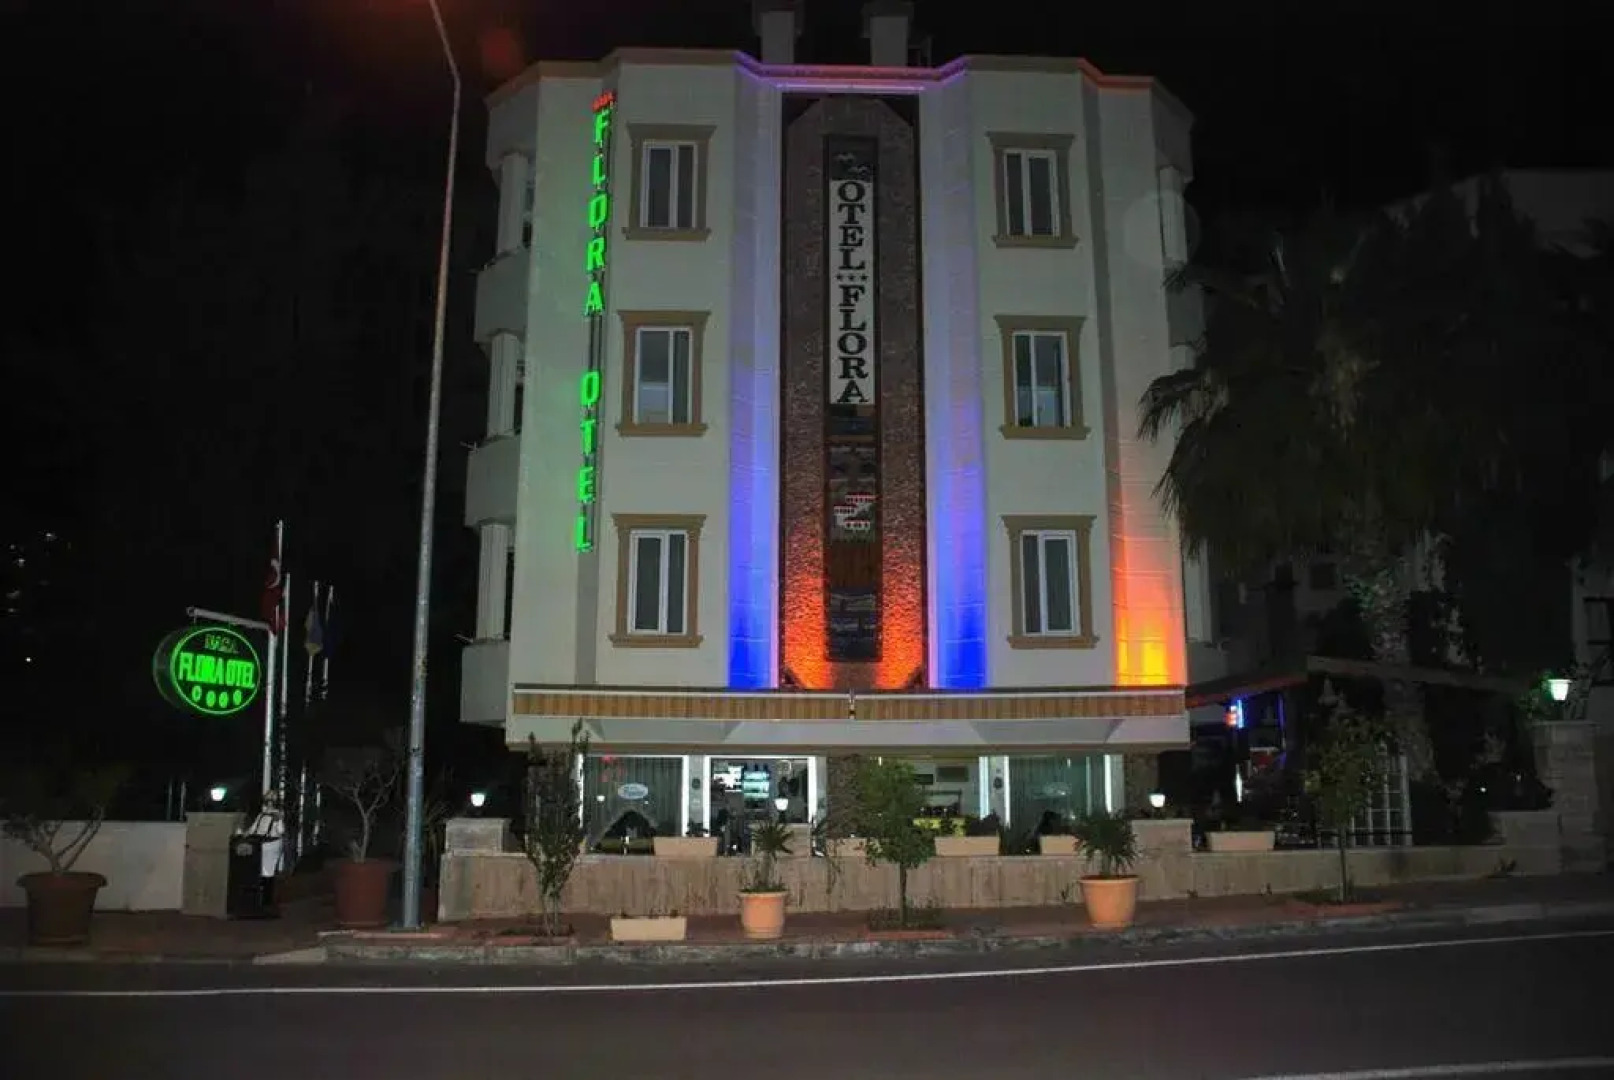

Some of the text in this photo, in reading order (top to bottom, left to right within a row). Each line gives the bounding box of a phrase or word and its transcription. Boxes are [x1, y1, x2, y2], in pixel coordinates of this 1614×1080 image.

[575, 108, 611, 553] FLORA OTEL
[837, 181, 869, 403] OTEL FLORA
[178, 652, 256, 689] FLORA OTEL
